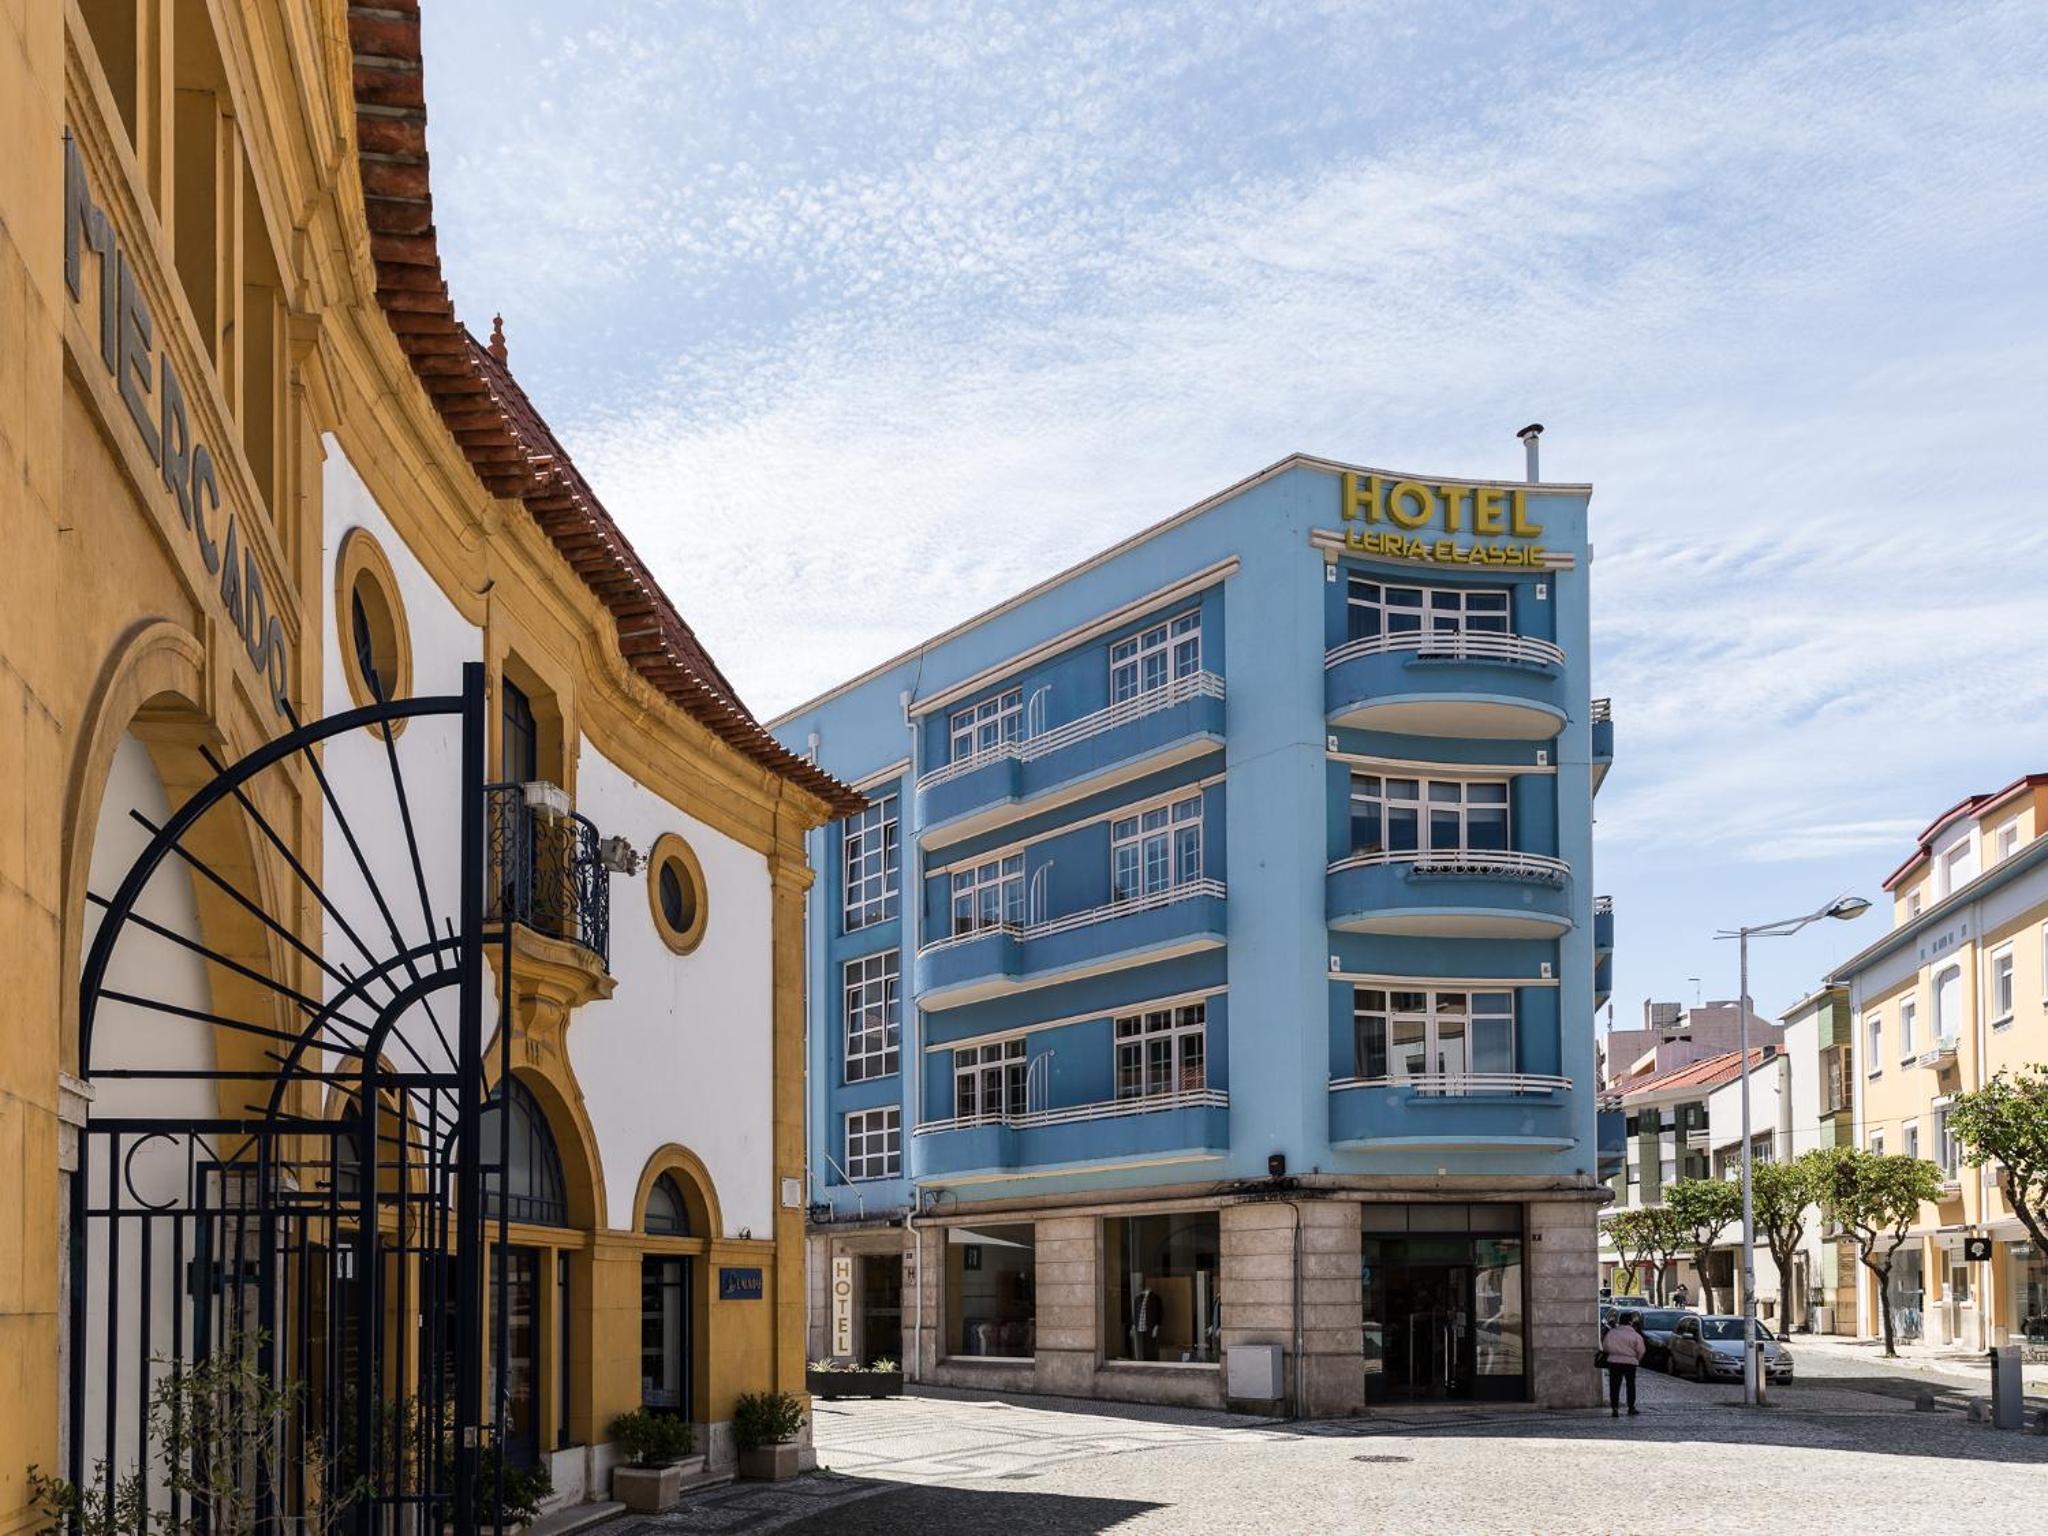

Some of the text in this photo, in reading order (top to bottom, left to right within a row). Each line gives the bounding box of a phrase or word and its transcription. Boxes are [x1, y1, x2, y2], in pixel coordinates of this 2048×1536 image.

[63, 125, 288, 717] MERCADO
[1342, 472, 1542, 536] HOTEL
[1345, 528, 1545, 567] LEIRIA CLASSIC
[835, 1262, 850, 1351] HOTEL
